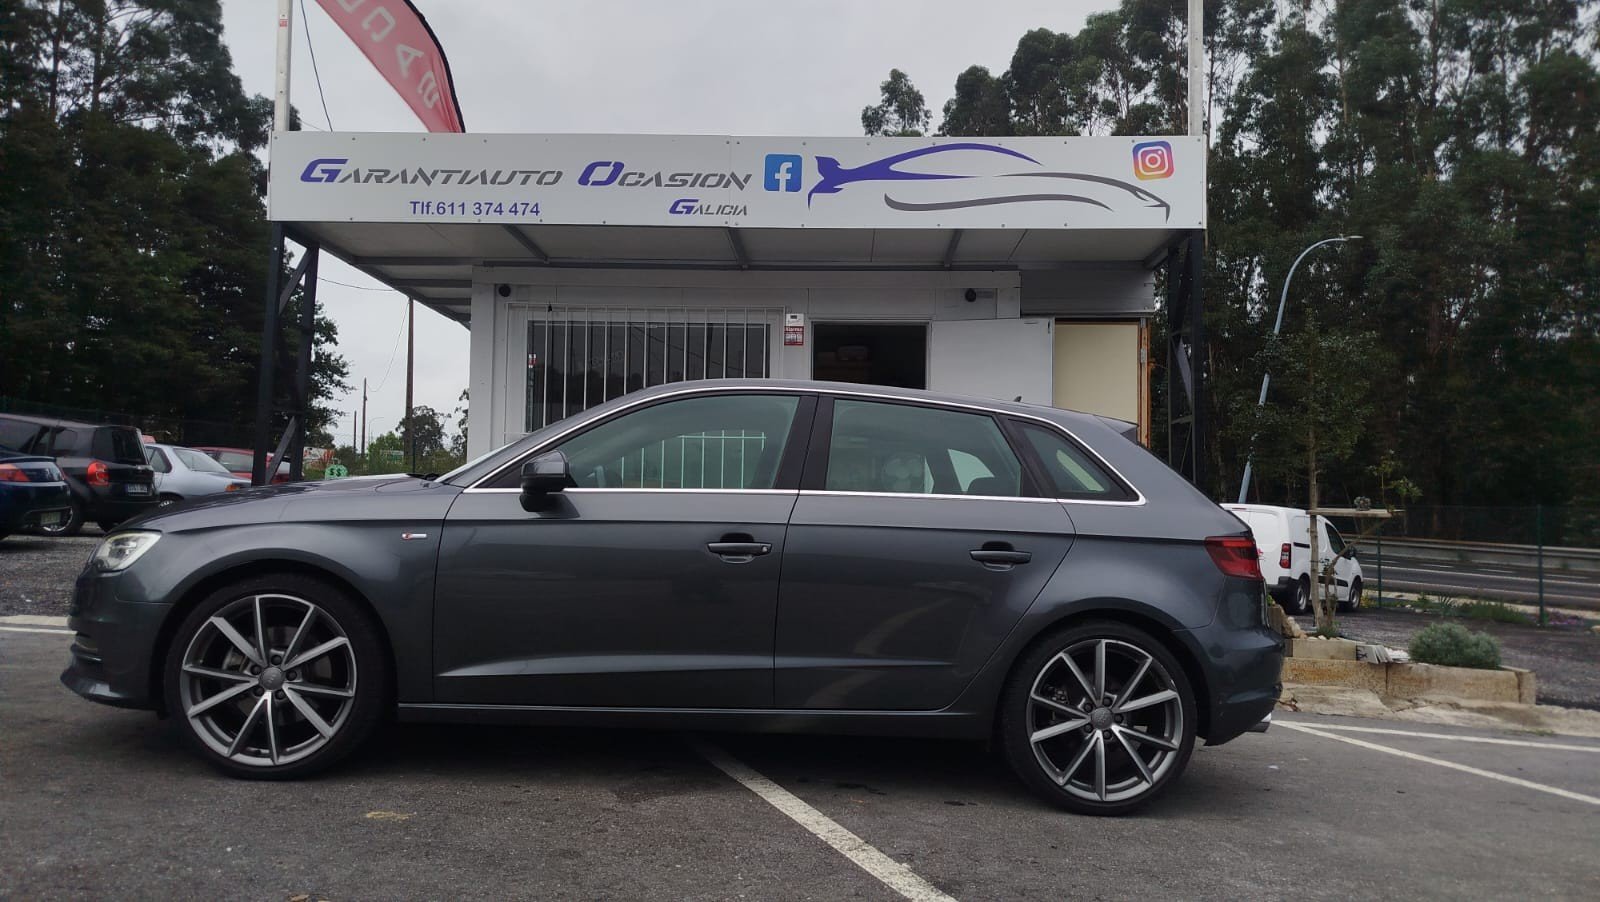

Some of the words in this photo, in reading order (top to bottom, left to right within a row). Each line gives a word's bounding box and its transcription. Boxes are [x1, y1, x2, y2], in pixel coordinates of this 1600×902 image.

[300, 158, 564, 187] GARANTIAUTO
[577, 161, 753, 191] OCASION
[472, 202, 505, 216] 374
[509, 202, 541, 217] 474
[669, 199, 748, 216] GALICIA
